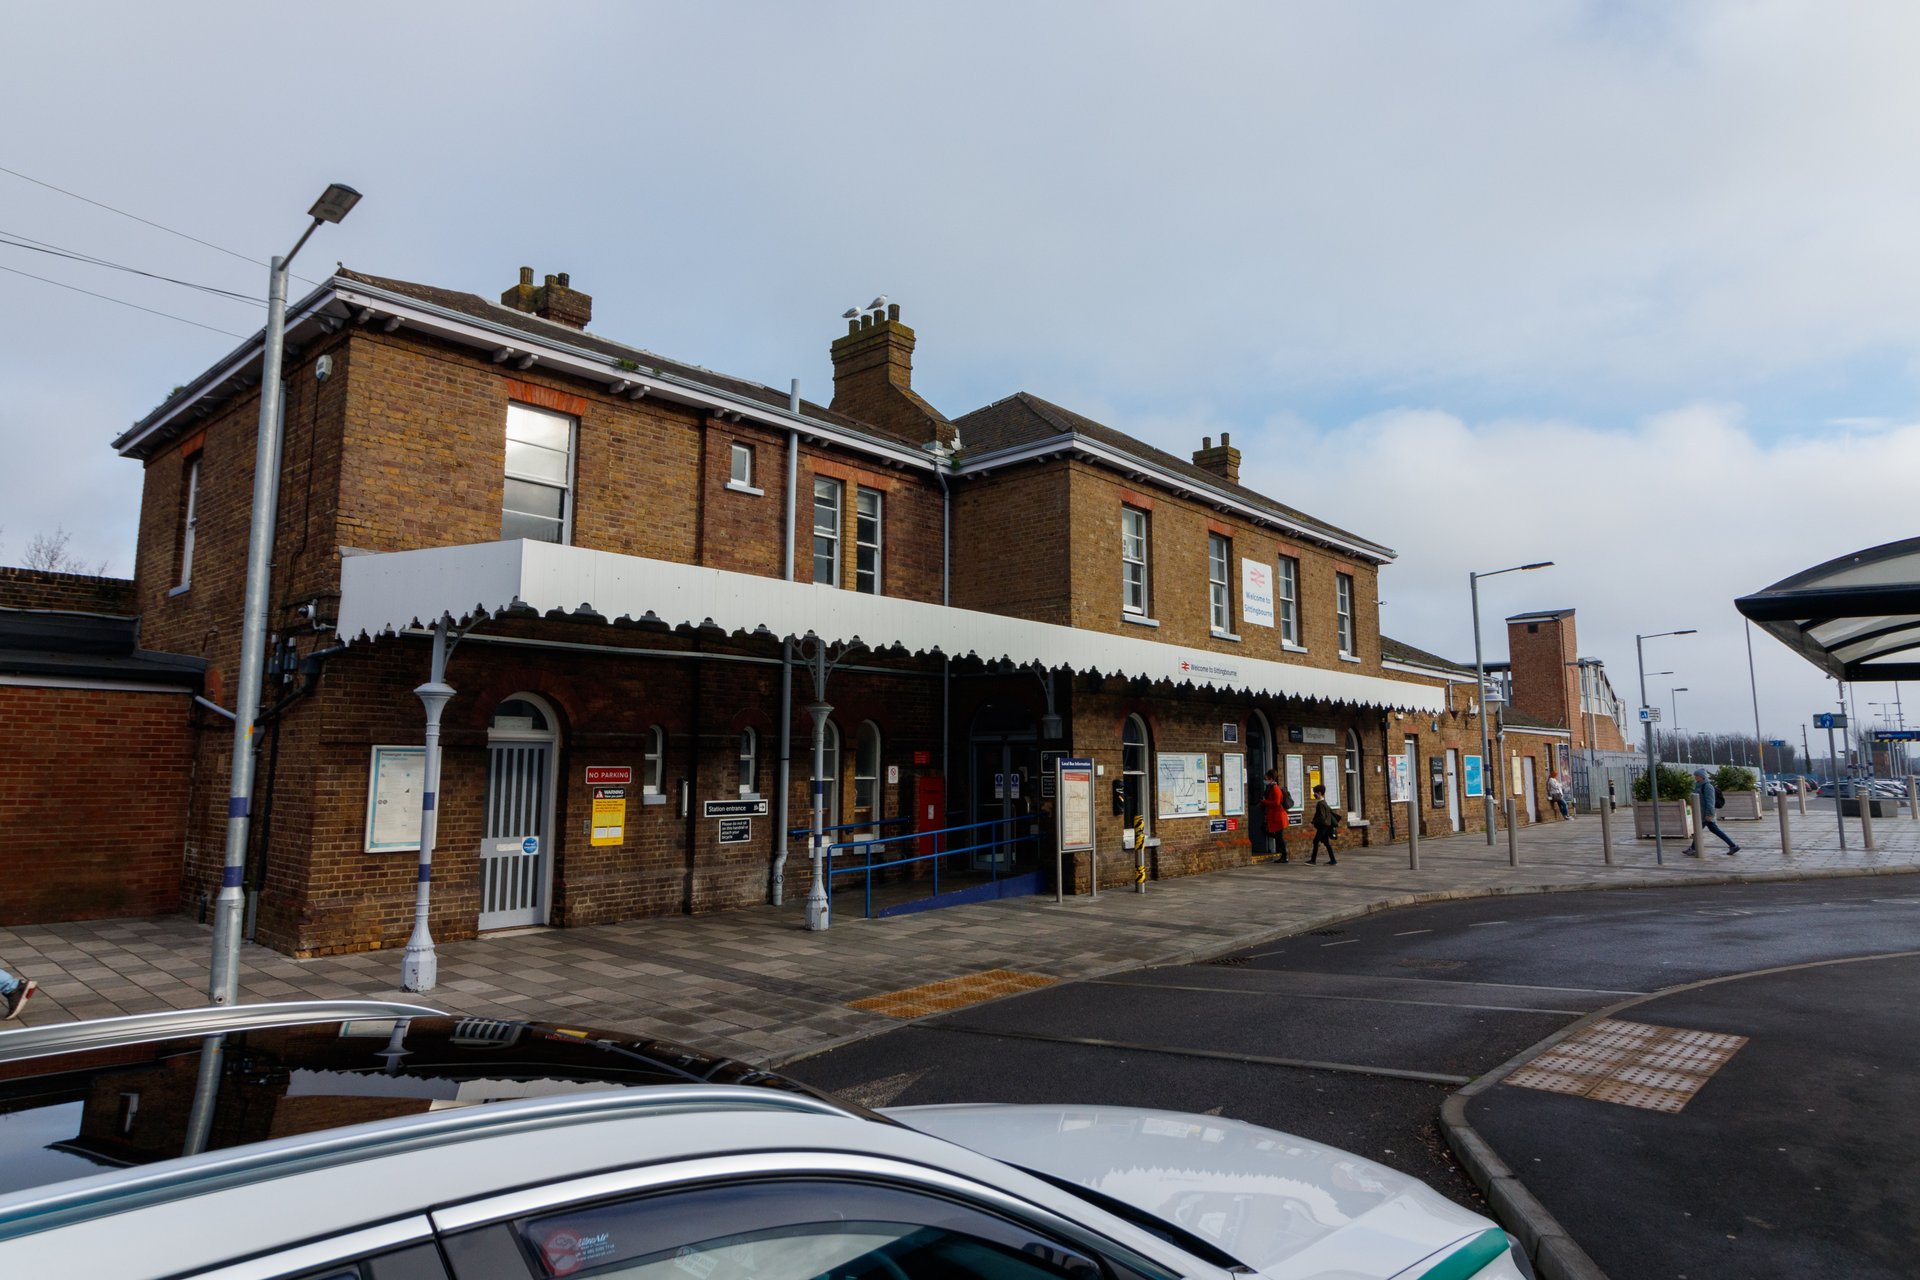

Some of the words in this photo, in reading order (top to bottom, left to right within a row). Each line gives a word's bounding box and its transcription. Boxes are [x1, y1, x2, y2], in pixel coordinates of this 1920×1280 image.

[1246, 592, 1265, 602] Welcome
[1244, 604, 1272, 617] Sittingbourne
[1191, 664, 1208, 673] Welcome
[1214, 667, 1237, 676] Sittingbourne
